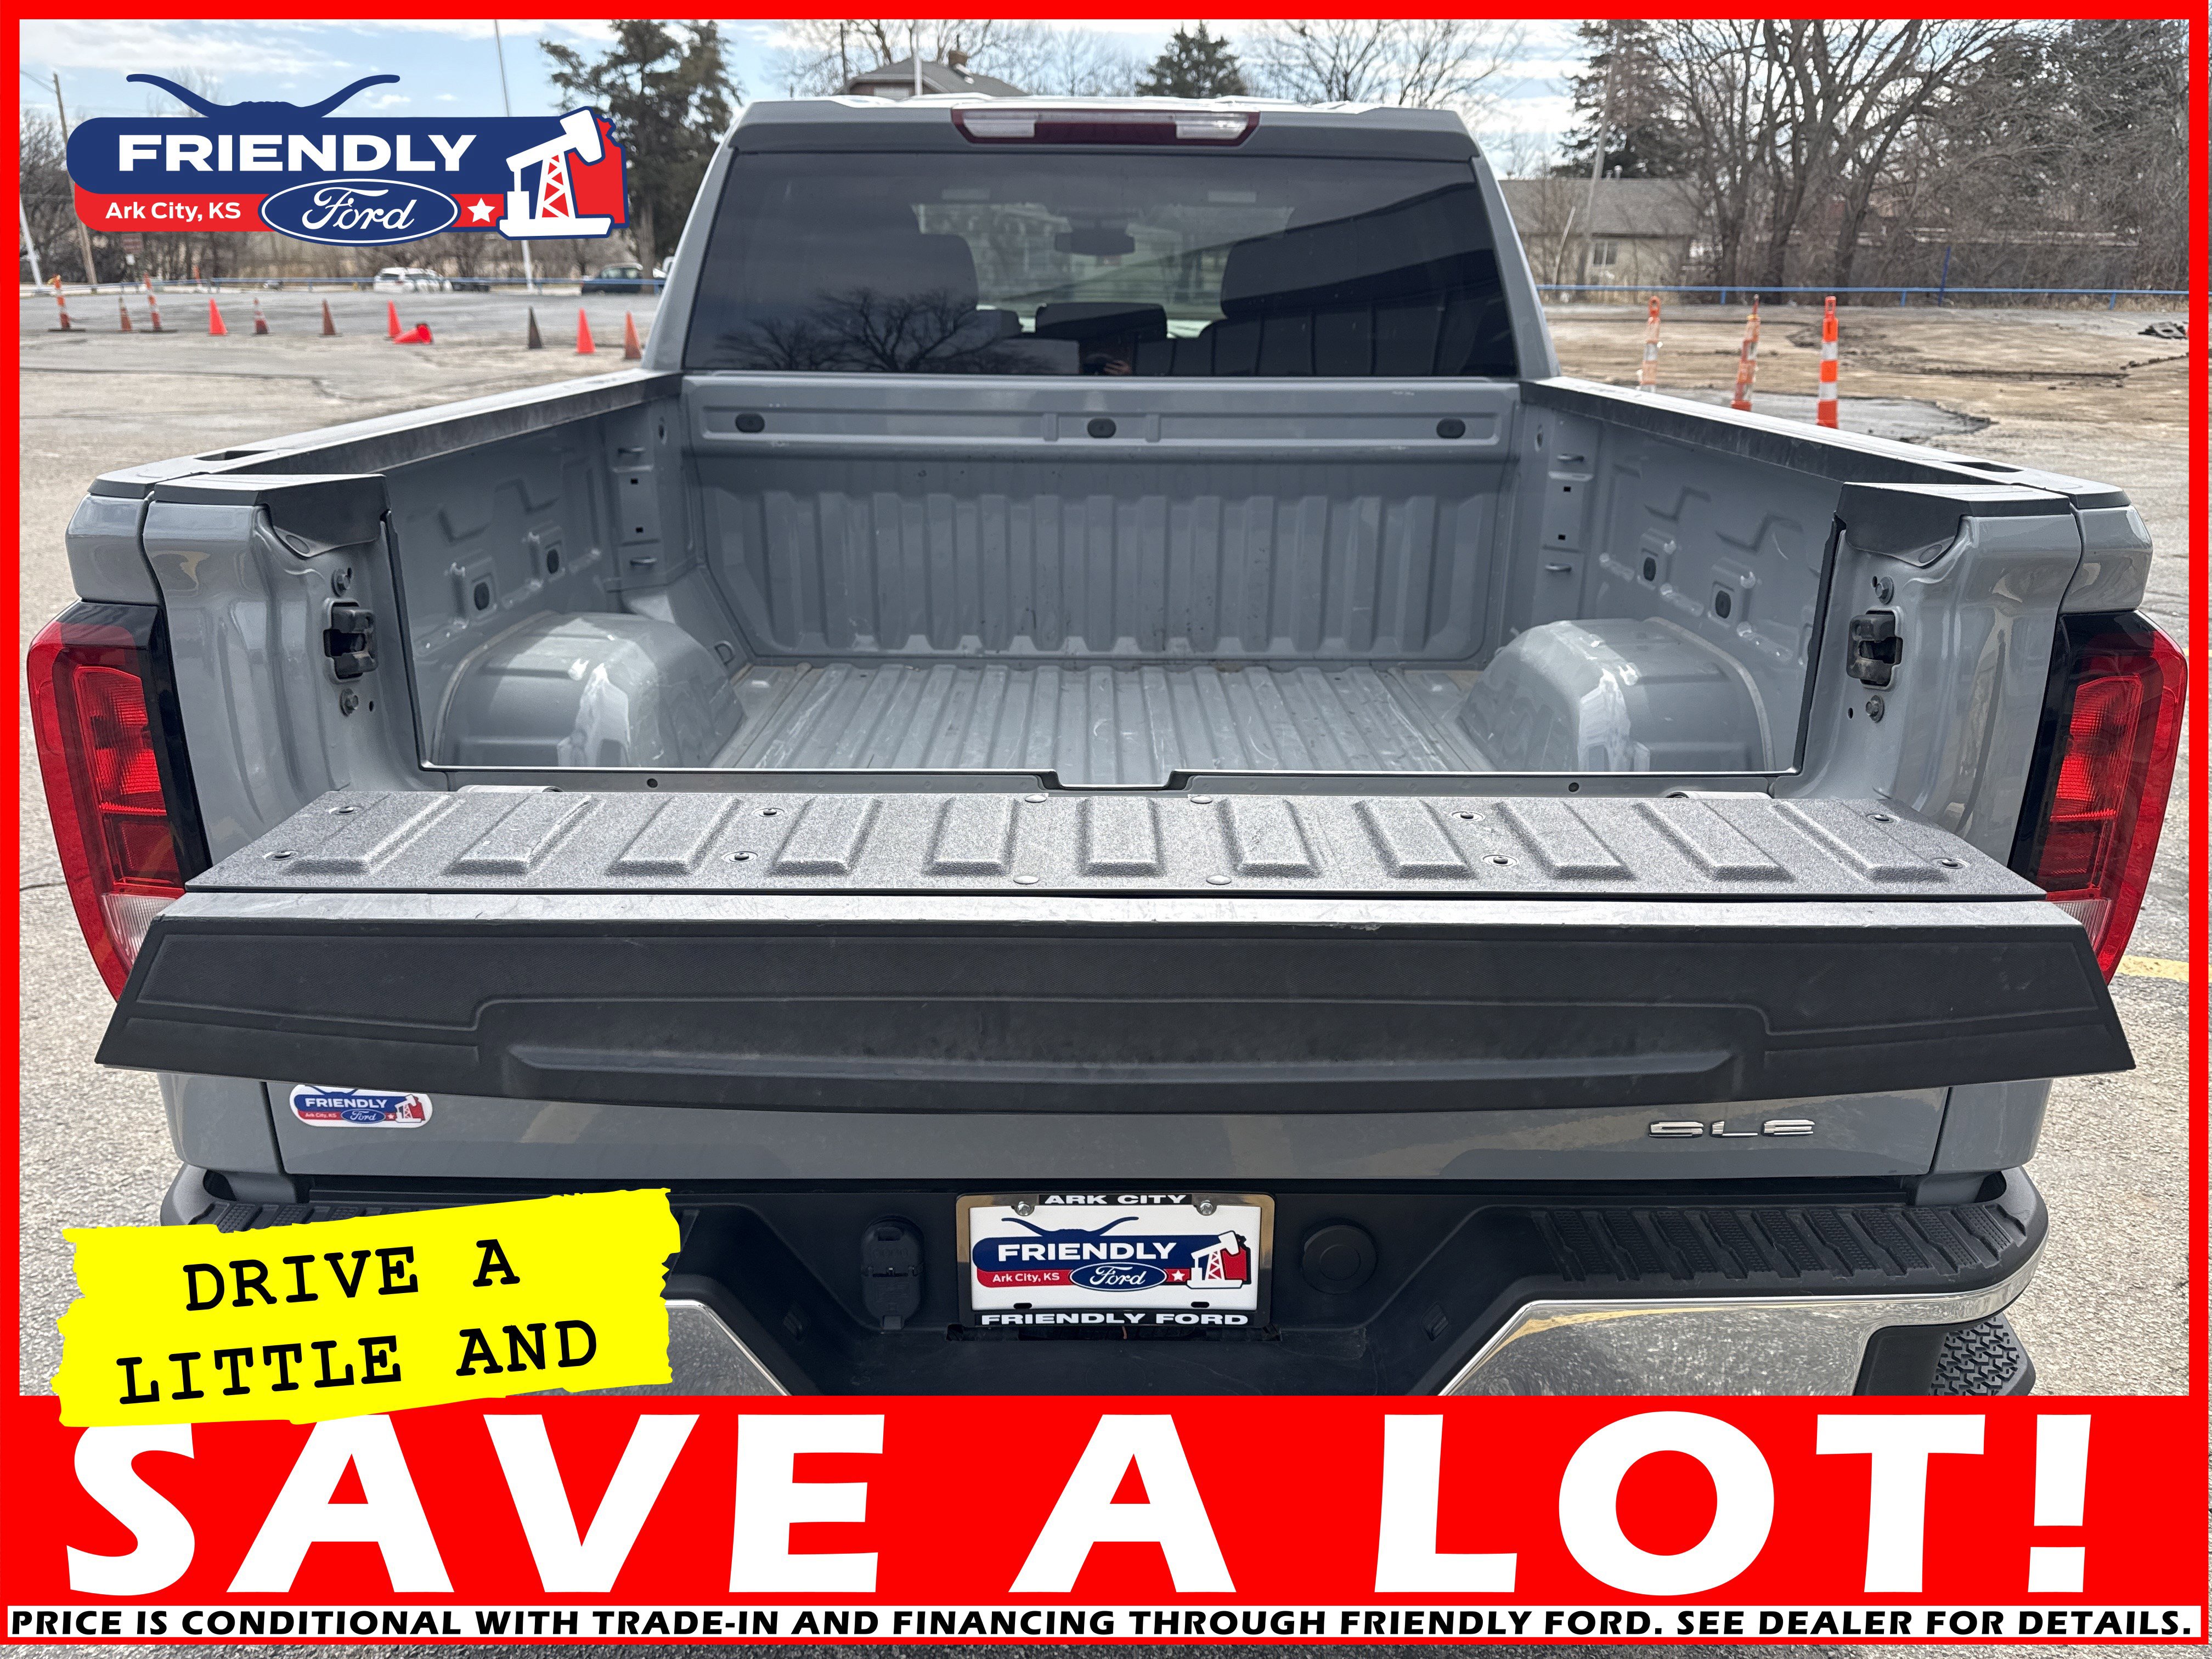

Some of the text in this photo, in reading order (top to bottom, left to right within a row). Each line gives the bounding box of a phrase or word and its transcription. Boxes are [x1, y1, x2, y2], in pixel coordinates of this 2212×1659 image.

[305, 1098, 387, 1108] FRIENDLY
[349, 1110, 377, 1121] Ford
[1649, 1120, 1816, 1137] SLE
[1045, 1194, 1187, 1204] ARK CITY
[998, 1242, 1177, 1262] FRIENDLY
[992, 1272, 1060, 1284] Ark City, KS
[1089, 1266, 1147, 1286] Ford
[981, 1313, 1248, 1325] FRIENDLY FORD
